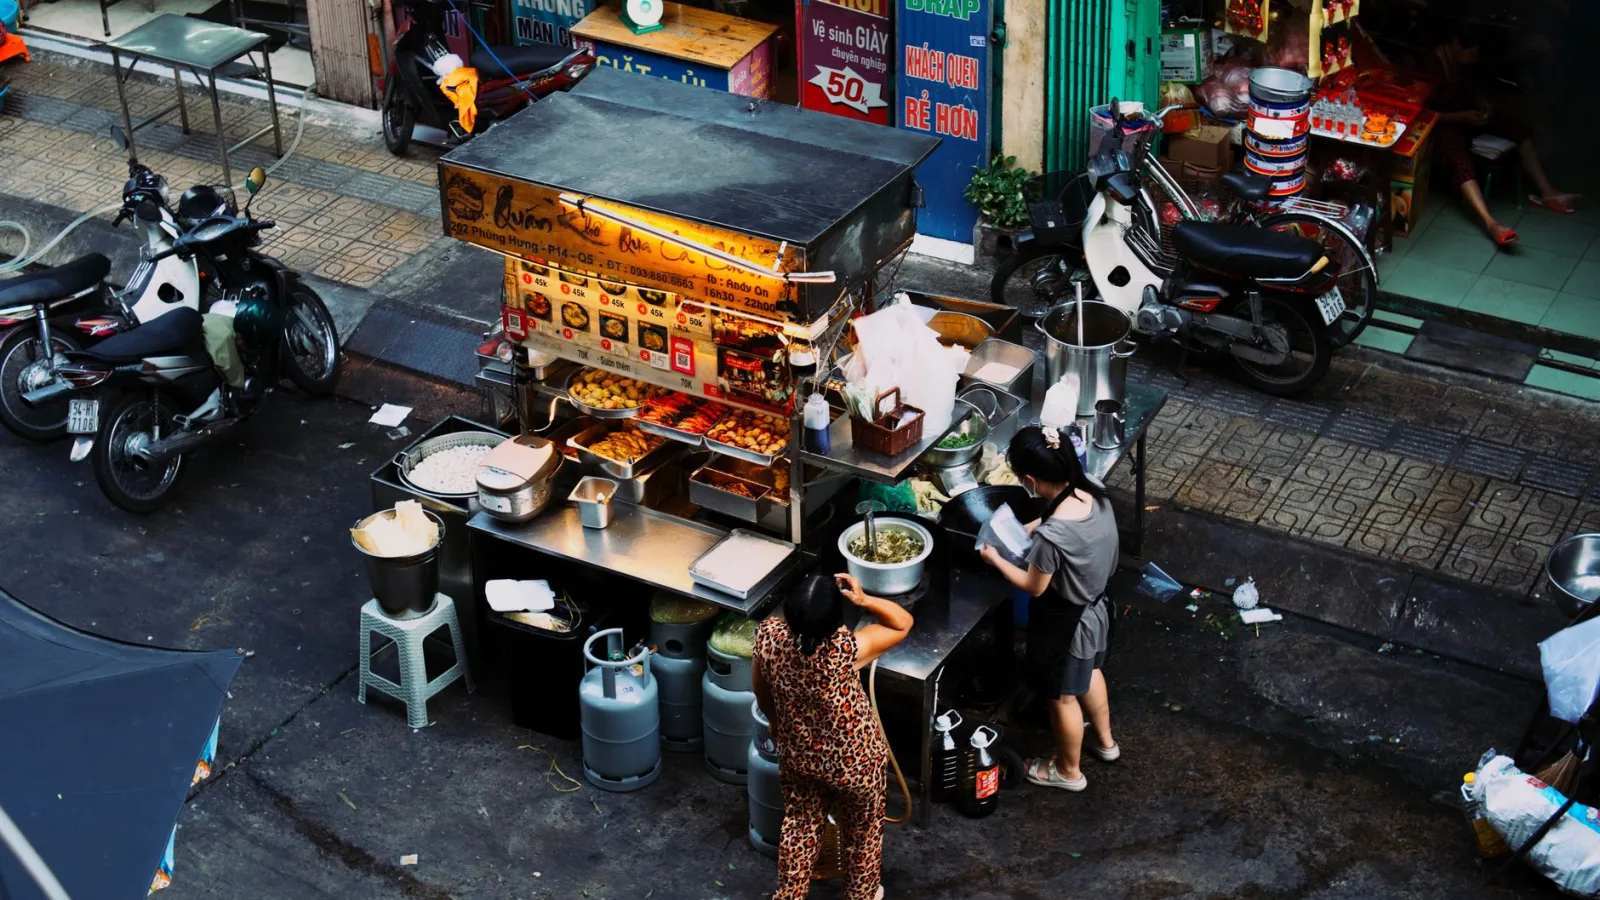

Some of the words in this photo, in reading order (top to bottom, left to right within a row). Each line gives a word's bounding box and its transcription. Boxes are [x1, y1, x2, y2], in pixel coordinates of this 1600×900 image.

[517, 15, 555, 46] MÀN
[812, 18, 825, 42] Vệ
[828, 26, 853, 46] sinh
[855, 23, 889, 55] GIÀY
[831, 46, 860, 64] chuyên
[860, 55, 887, 73] nghiệp
[905, 42, 945, 84] KHÁCH
[947, 53, 979, 90] QUEN
[905, 90, 931, 131] RẺ
[935, 101, 978, 141] HƠN
[450, 221, 469, 235] 202
[508, 234, 539, 256] Hưng
[548, 244, 569, 259] P14
[578, 251, 594, 265] Q5
[606, 260, 622, 273] ĐT
[534, 277, 548, 288] 45k
[572, 287, 586, 298] 45k
[706, 273, 717, 285] fb
[726, 279, 752, 298] Andy
[611, 298, 625, 309] 45k
[704, 286, 735, 303] 16h30
[744, 296, 777, 313] 22h00
[650, 308, 664, 318] 45k
[689, 317, 703, 328] 50k
[72, 418, 93, 432] 7106
